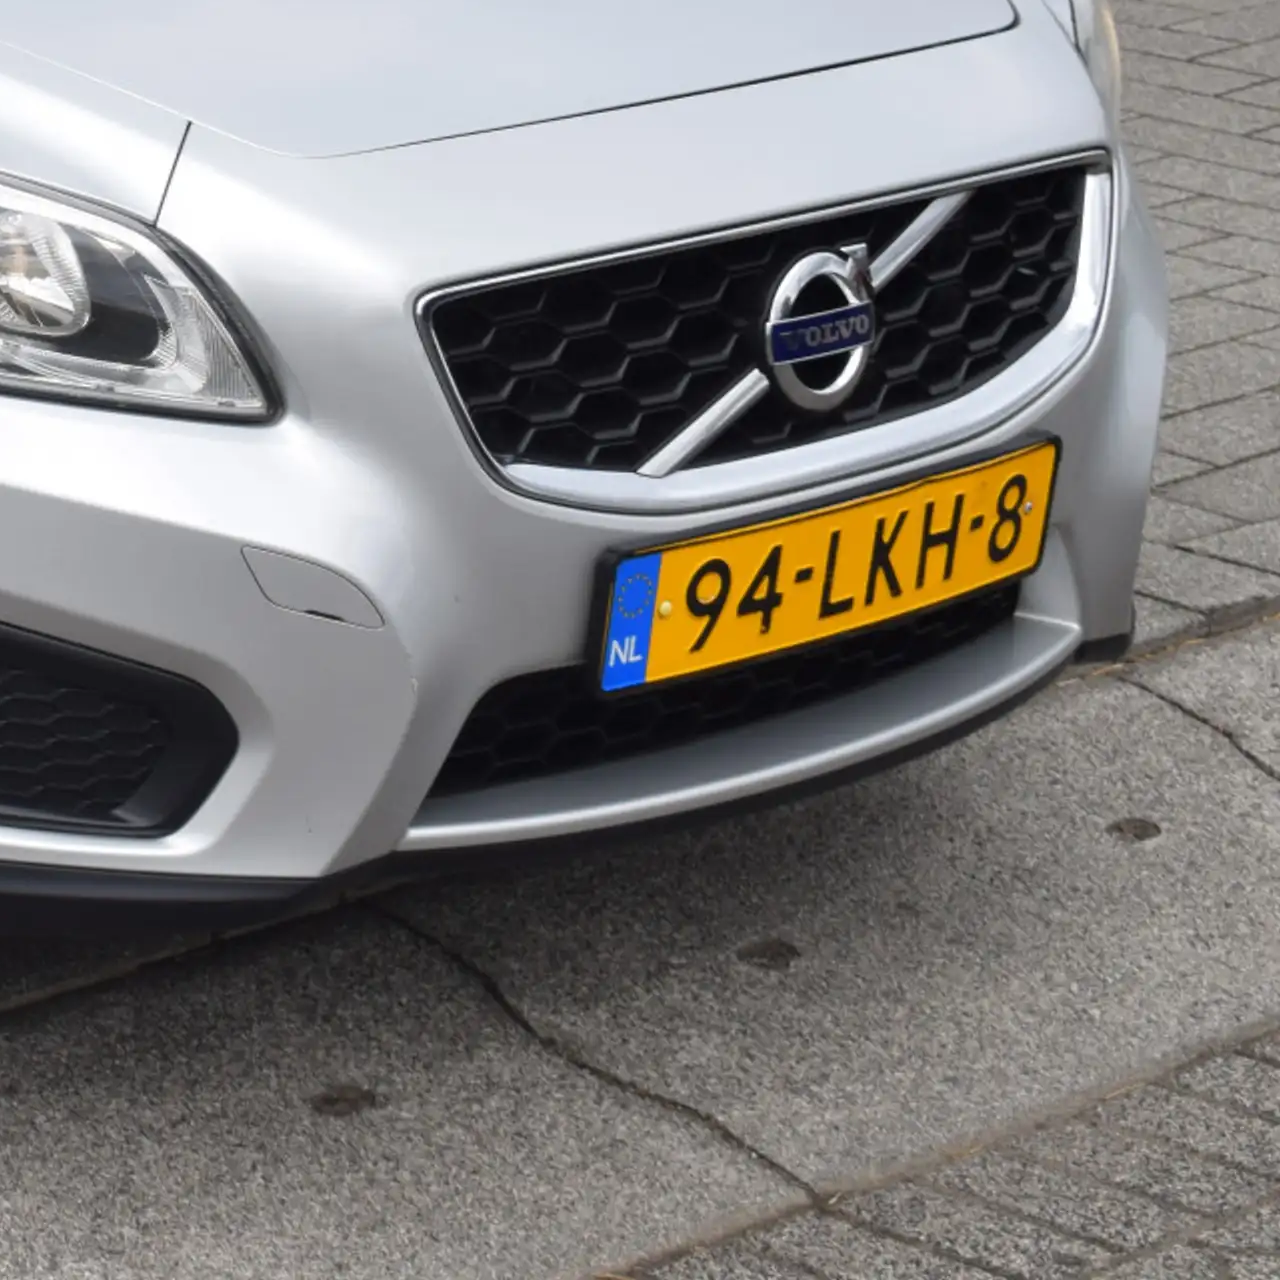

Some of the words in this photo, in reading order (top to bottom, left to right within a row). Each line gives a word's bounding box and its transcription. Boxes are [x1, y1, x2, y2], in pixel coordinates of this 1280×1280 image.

[779, 313, 870, 352] VOLVO
[684, 473, 1029, 653] 94-LKH-8
[608, 639, 643, 667] NL
